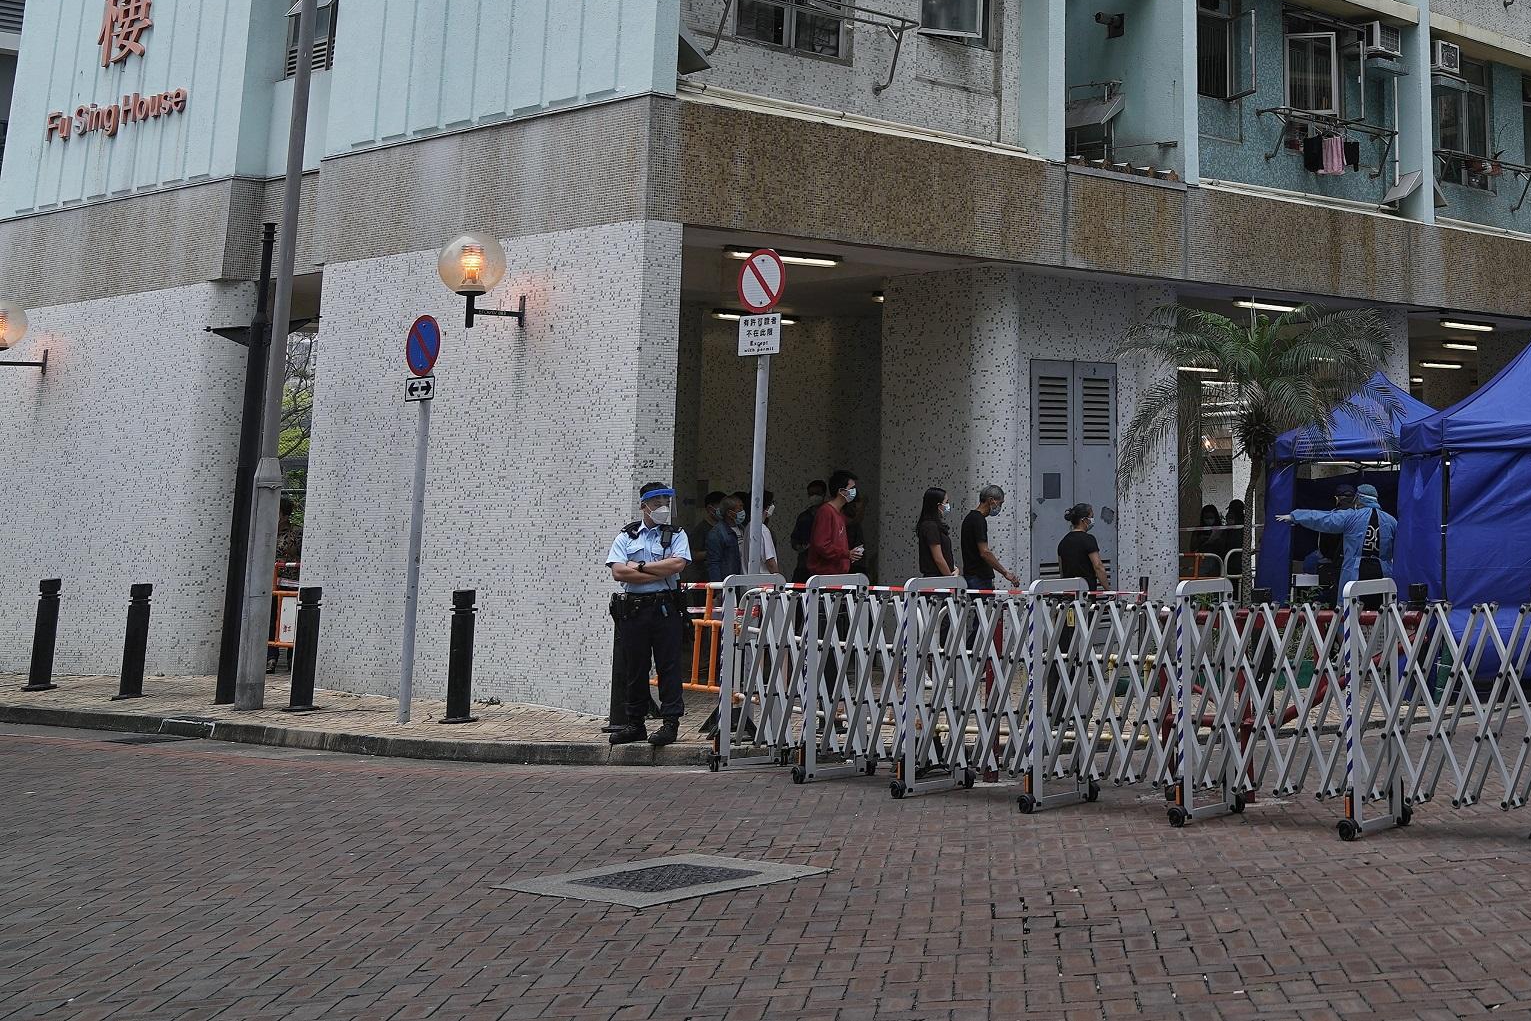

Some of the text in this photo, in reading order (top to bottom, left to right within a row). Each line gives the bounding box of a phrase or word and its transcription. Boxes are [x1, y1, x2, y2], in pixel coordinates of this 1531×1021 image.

[46, 88, 188, 143] Fu Sing House
